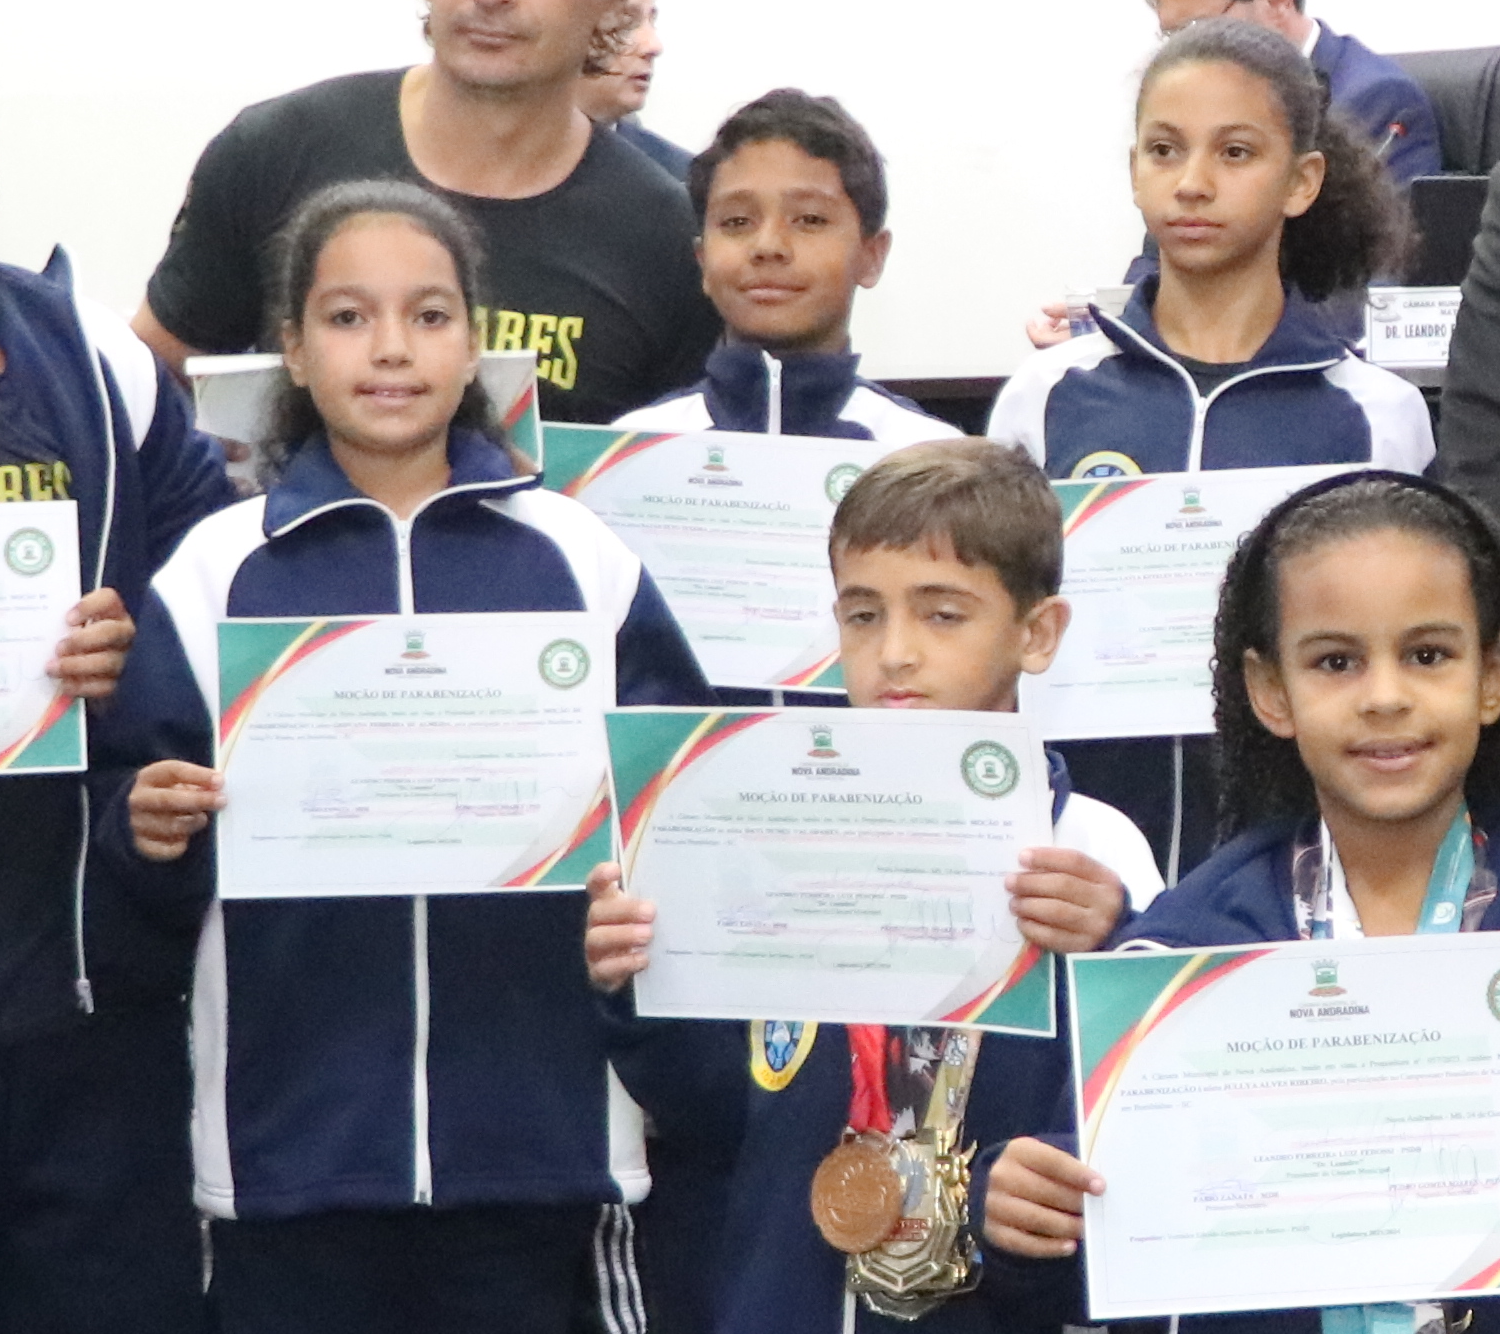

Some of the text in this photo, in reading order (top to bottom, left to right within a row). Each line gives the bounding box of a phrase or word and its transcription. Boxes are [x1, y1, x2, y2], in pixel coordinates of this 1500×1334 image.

[1385, 323, 1447, 339] DR. LEANDRO
[642, 494, 792, 513] MOÇÃO DE PARABENIZAÇÃO
[1120, 542, 1162, 556] MOÇÃO
[1164, 543, 1179, 554] DE
[333, 687, 503, 701] MOÇÃO DE PARABENIZAÇÃO
[738, 788, 924, 807] MOÇÃO DE PARABENIZAÇÃO
[1289, 1006, 1315, 1019] NOVA
[1317, 1004, 1370, 1017] ANDRADINA
[1226, 1028, 1442, 1054] MOÇÃO DE PARABENIZAÇÃO
